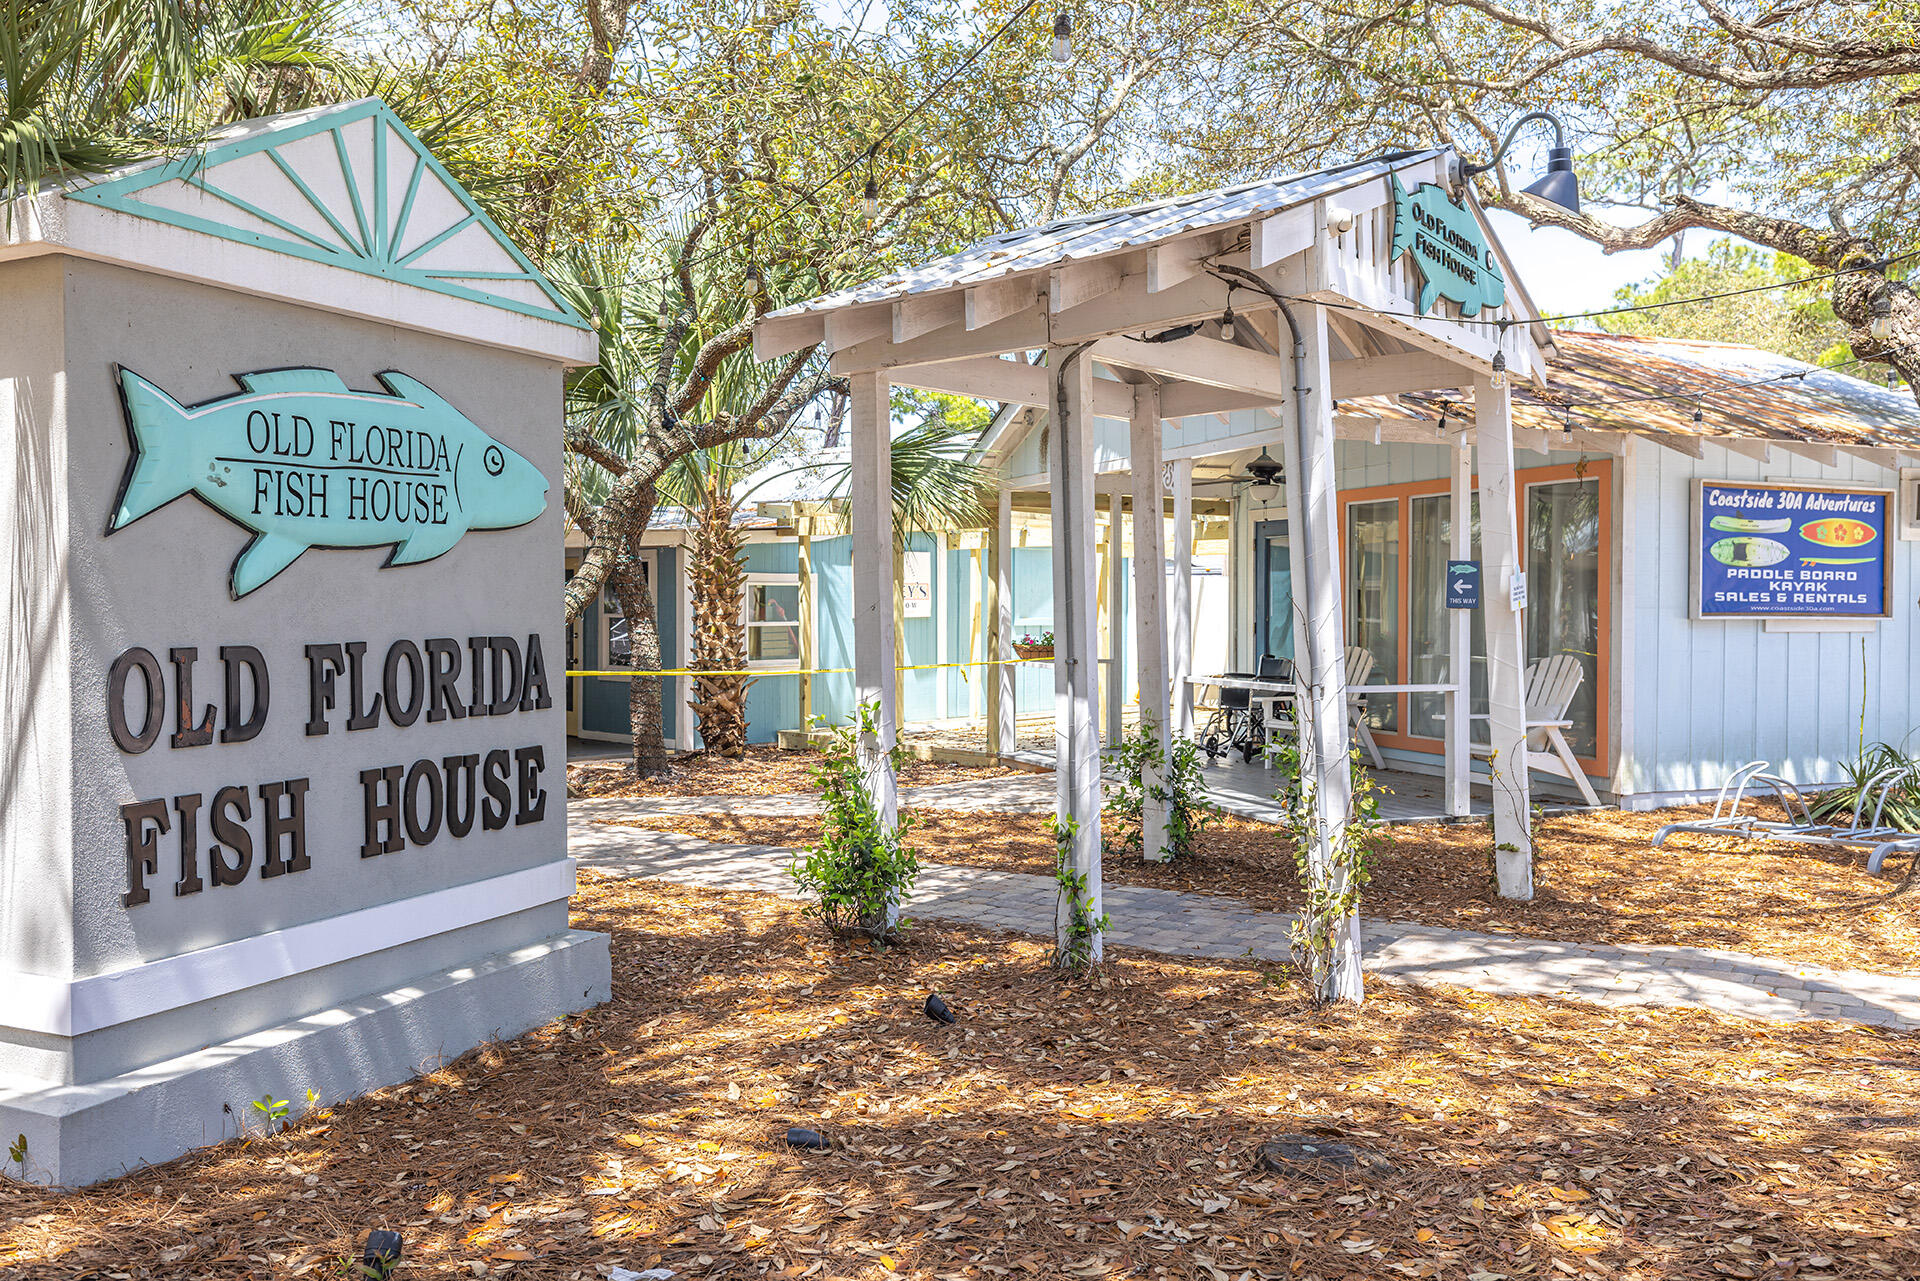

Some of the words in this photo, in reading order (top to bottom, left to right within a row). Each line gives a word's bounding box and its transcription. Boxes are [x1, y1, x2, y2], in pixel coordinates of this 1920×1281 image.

[1412, 202, 1436, 231] OLD
[1436, 218, 1478, 261] FLORIDA
[1415, 232, 1441, 263] FISH
[1442, 249, 1477, 286] HOUSE
[246, 410, 314, 458] OLD
[329, 420, 451, 472] FLORIDA
[251, 468, 329, 518] FISH
[347, 477, 449, 525] HOUSE
[1709, 489, 1773, 508] Coastside
[1777, 492, 1802, 510] 30A
[1805, 494, 1876, 513] Adventures
[1714, 592, 1771, 602] SALES
[1776, 593, 1788, 603] &
[1793, 593, 1867, 604] RENTALS
[1727, 568, 1794, 580] PADDLE
[1800, 571, 1858, 581] BOARD
[1769, 581, 1828, 592] KAYAK
[107, 646, 270, 754] OLD
[305, 633, 553, 736] FLORIDA
[121, 778, 311, 908] FISH
[360, 745, 547, 859] HOUSE
